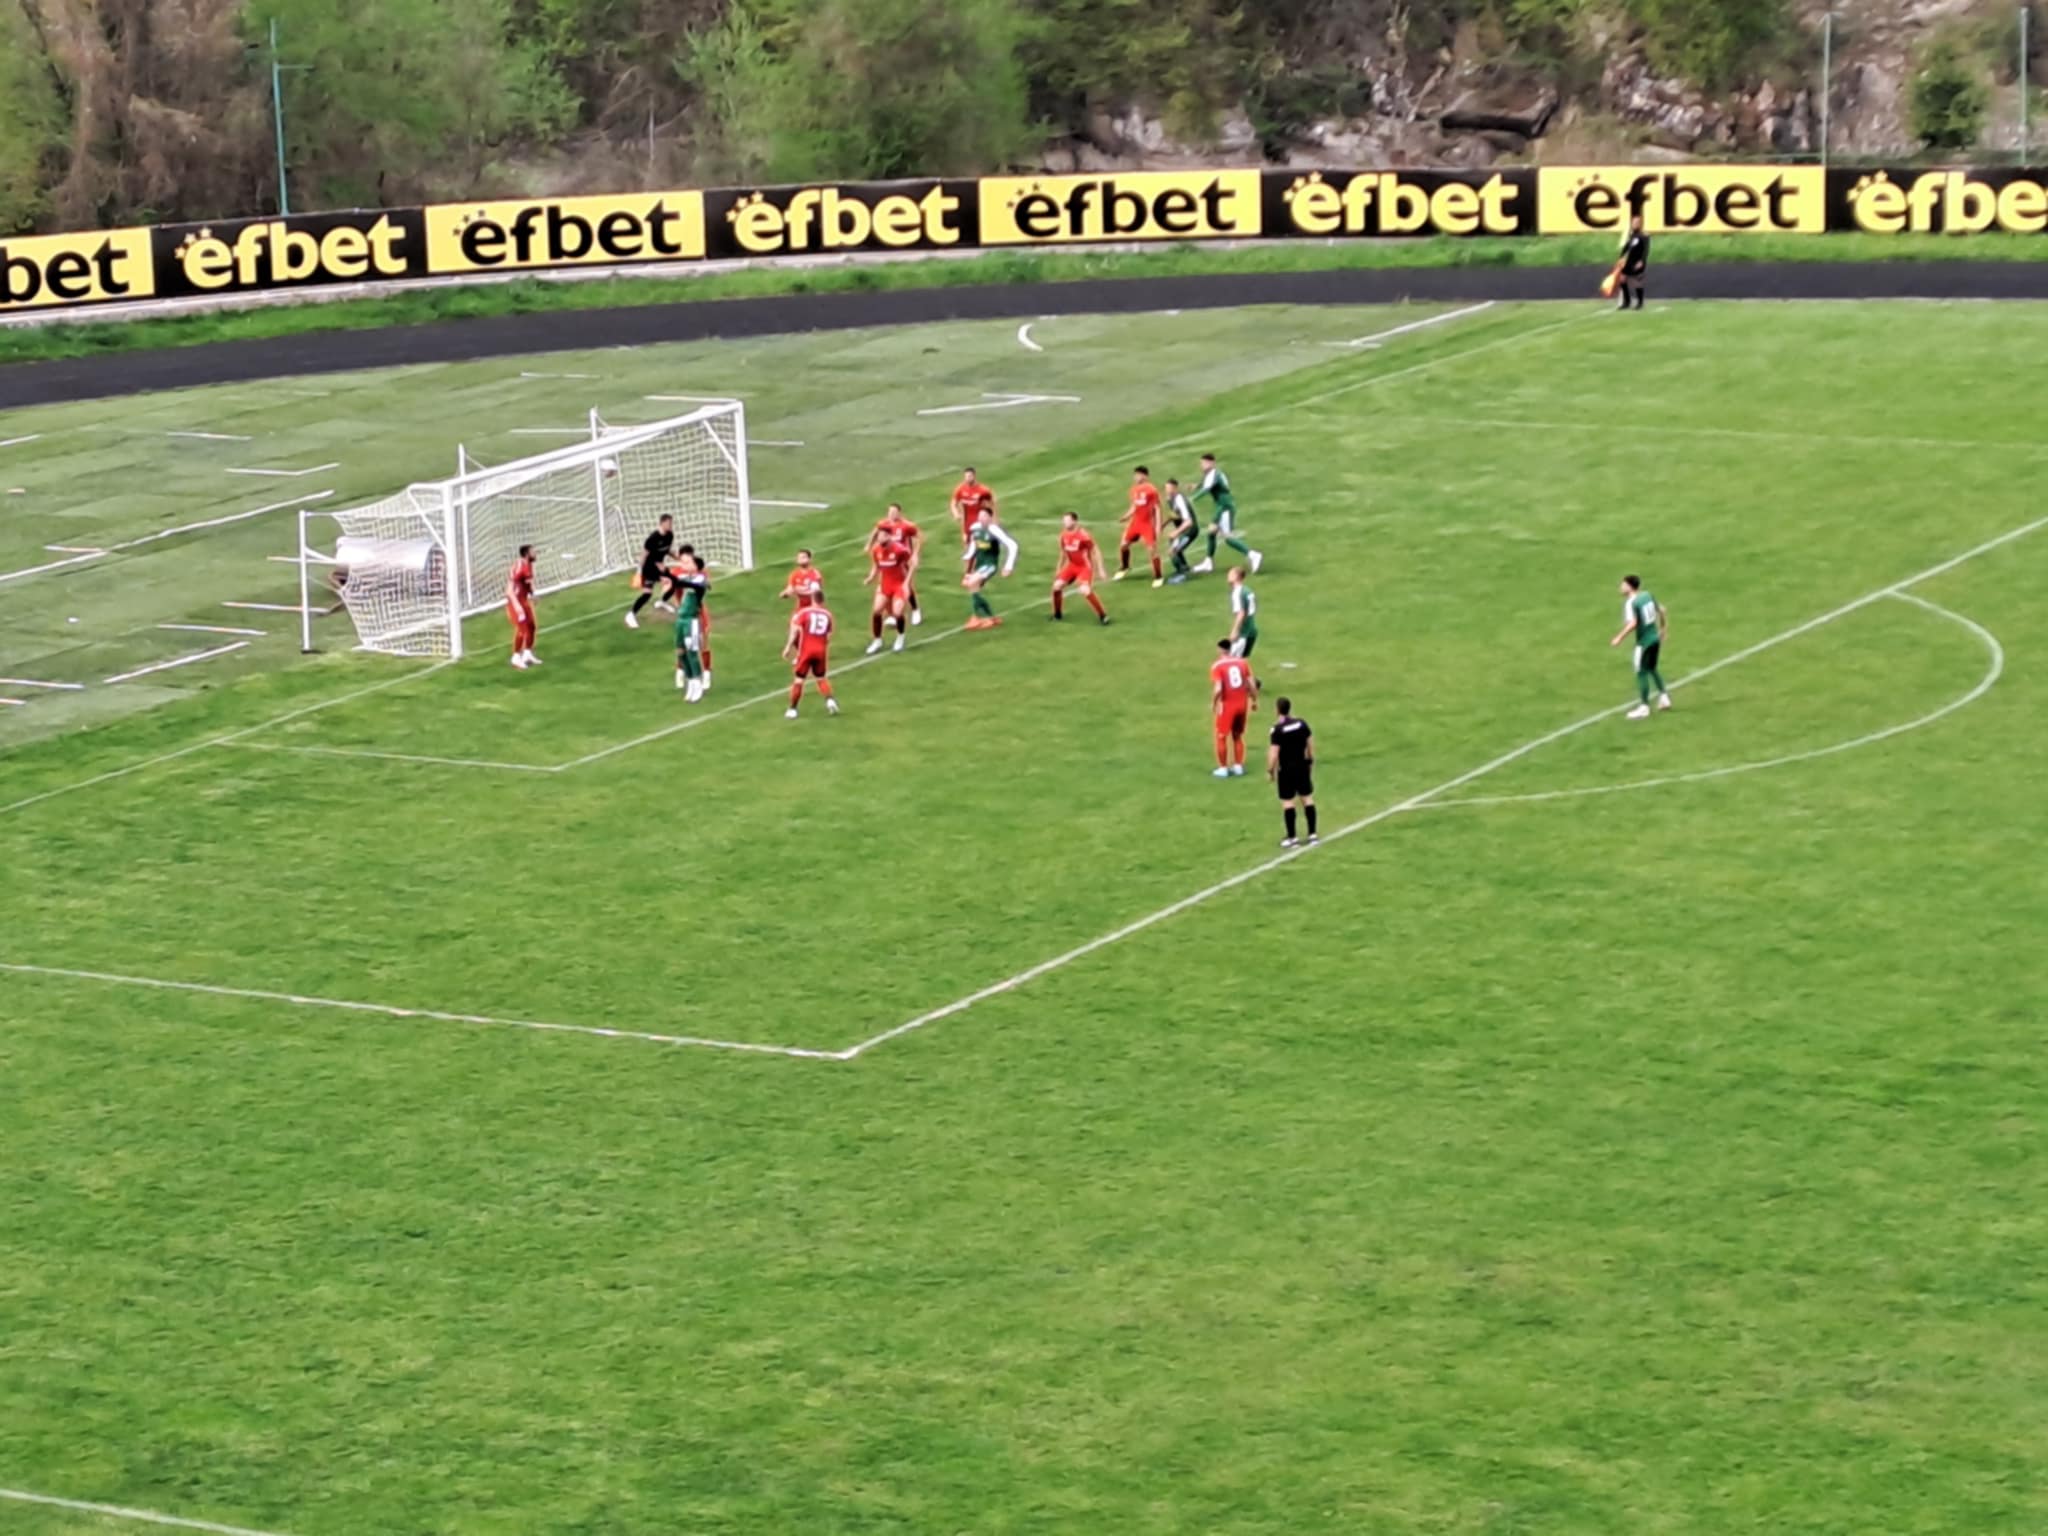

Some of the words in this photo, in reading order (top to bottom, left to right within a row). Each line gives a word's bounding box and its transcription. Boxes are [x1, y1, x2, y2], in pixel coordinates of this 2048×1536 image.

[734, 185, 960, 252] efbet
[1014, 177, 1237, 237] efbet
[1291, 172, 1518, 234] efbet
[1573, 172, 1800, 229] efbet
[183, 215, 407, 287] efbet
[462, 200, 681, 265] efbet
[809, 612, 828, 635] 13
[1228, 666, 1243, 688] 8
